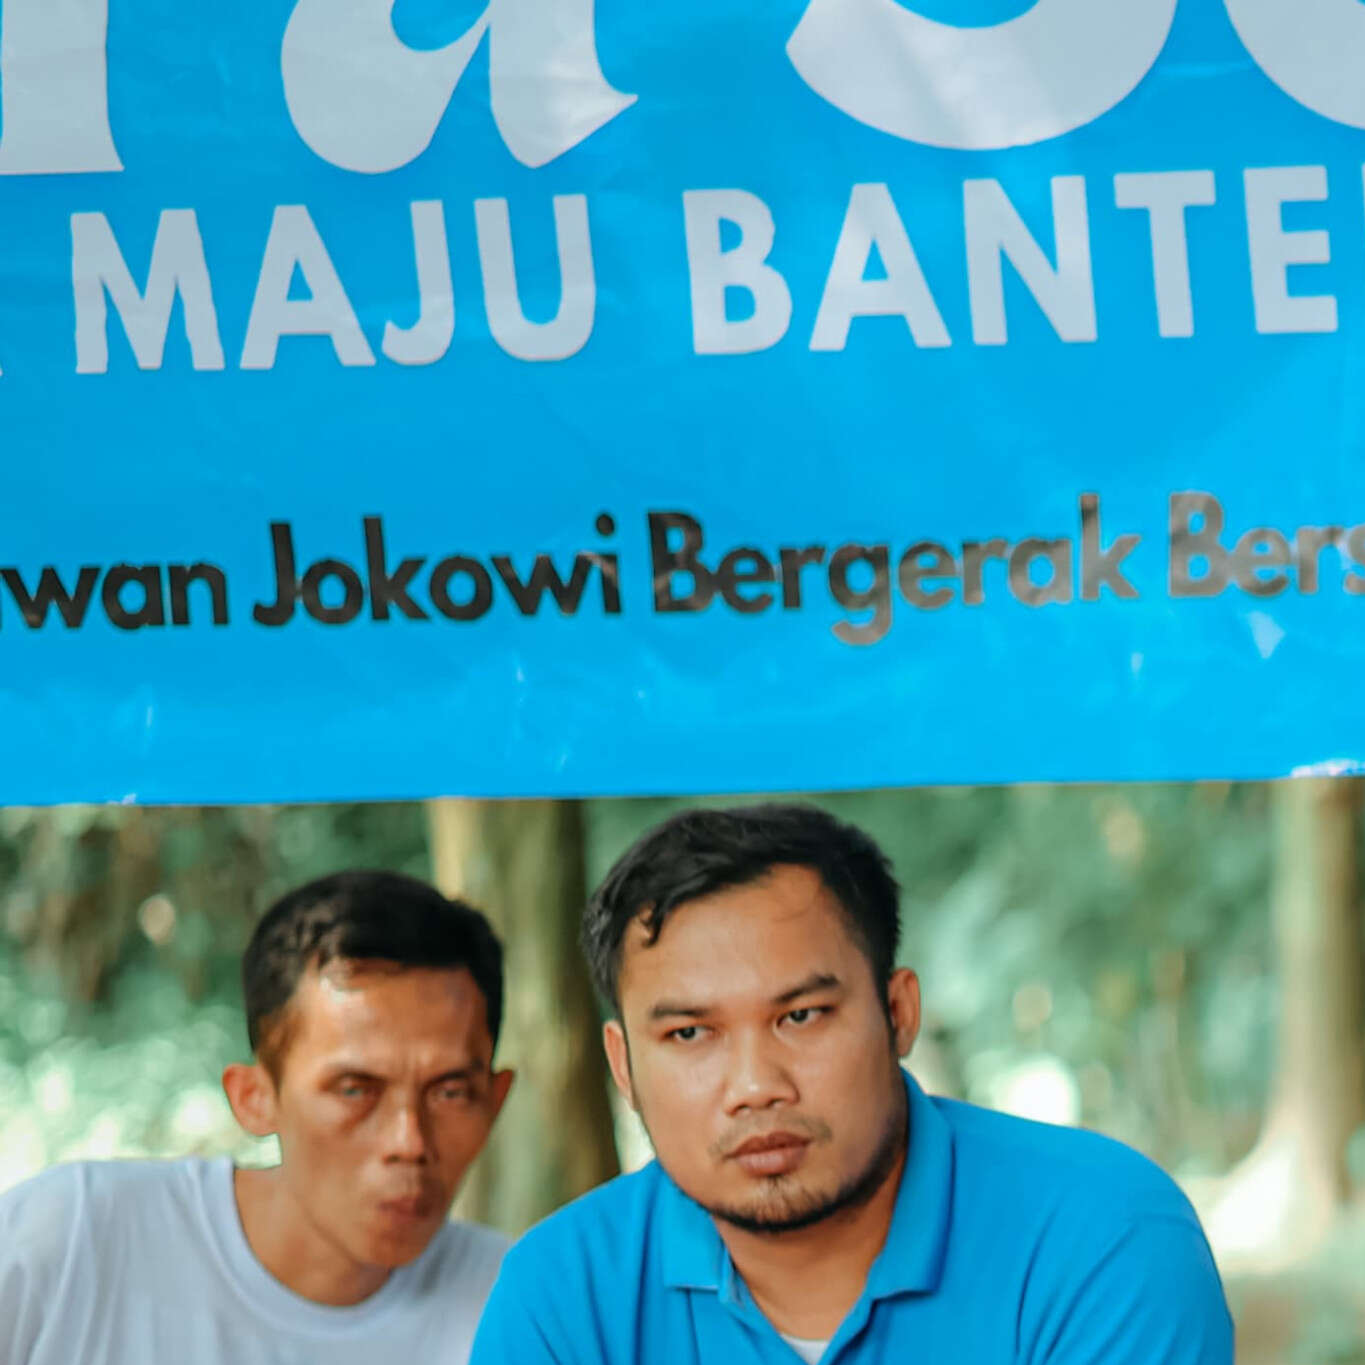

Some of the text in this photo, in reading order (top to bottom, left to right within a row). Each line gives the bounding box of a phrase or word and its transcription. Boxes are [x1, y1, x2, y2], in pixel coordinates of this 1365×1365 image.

[71, 194, 597, 374] MAJU
[0, 561, 230, 632] wan
[252, 511, 622, 629] Jokowi
[645, 493, 1139, 646] Bergerak
